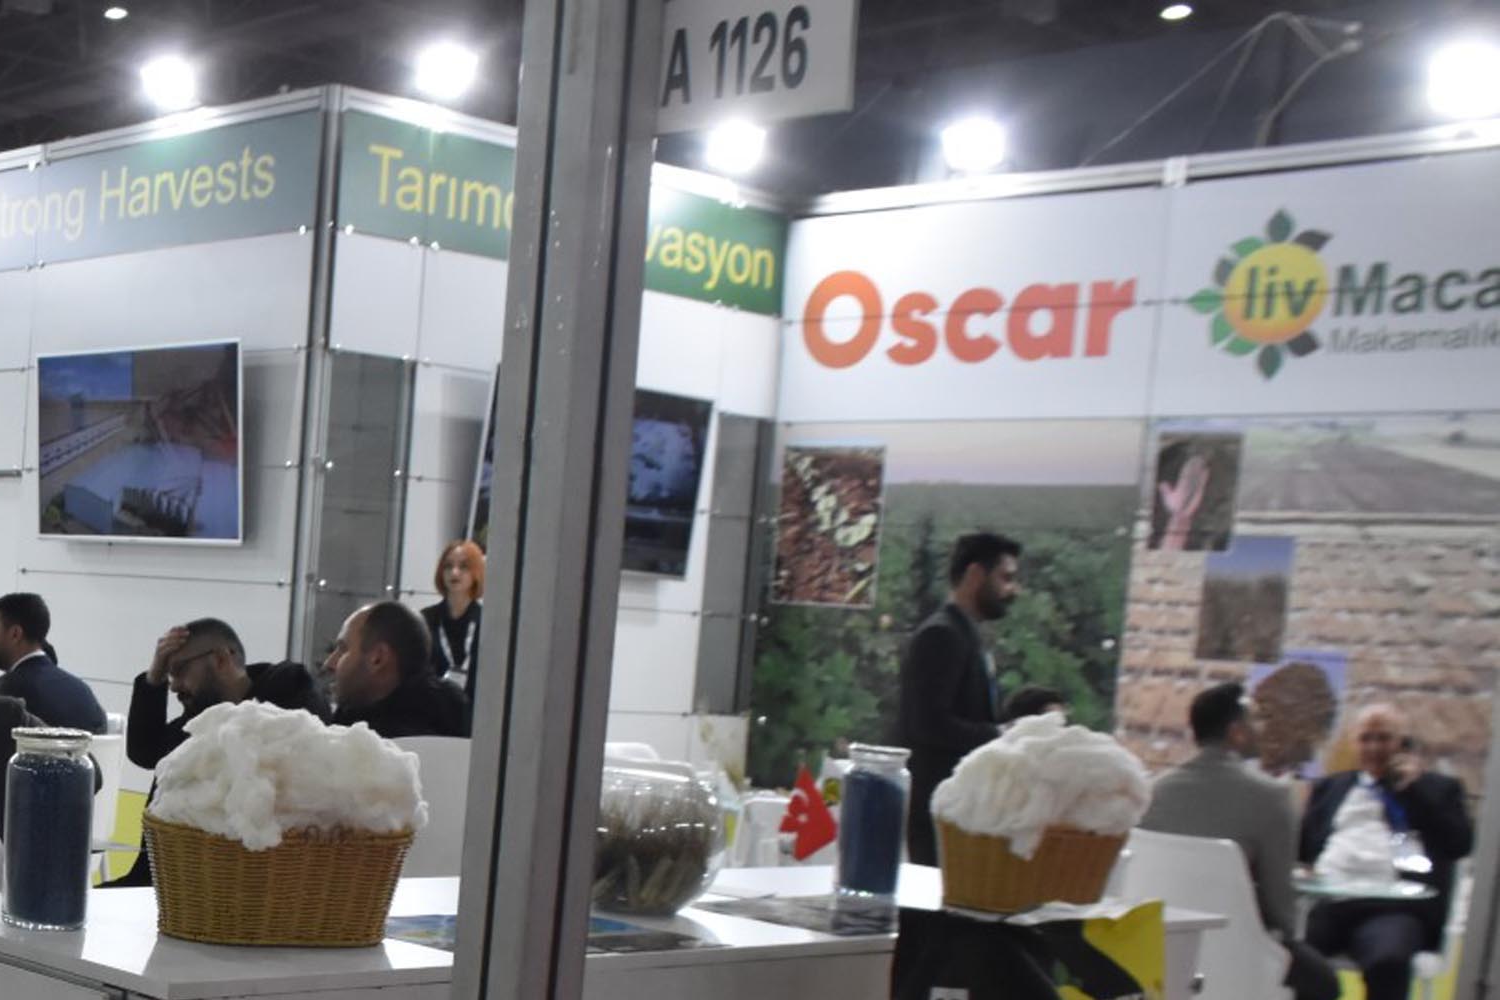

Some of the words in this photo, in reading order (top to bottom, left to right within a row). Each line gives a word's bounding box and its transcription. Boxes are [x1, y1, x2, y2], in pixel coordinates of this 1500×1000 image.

[661, 27, 691, 107] A
[709, 5, 811, 99] 1126
[99, 144, 276, 220] Harvests
[801, 269, 1138, 369] Oscar
[1240, 265, 1318, 321] liv
